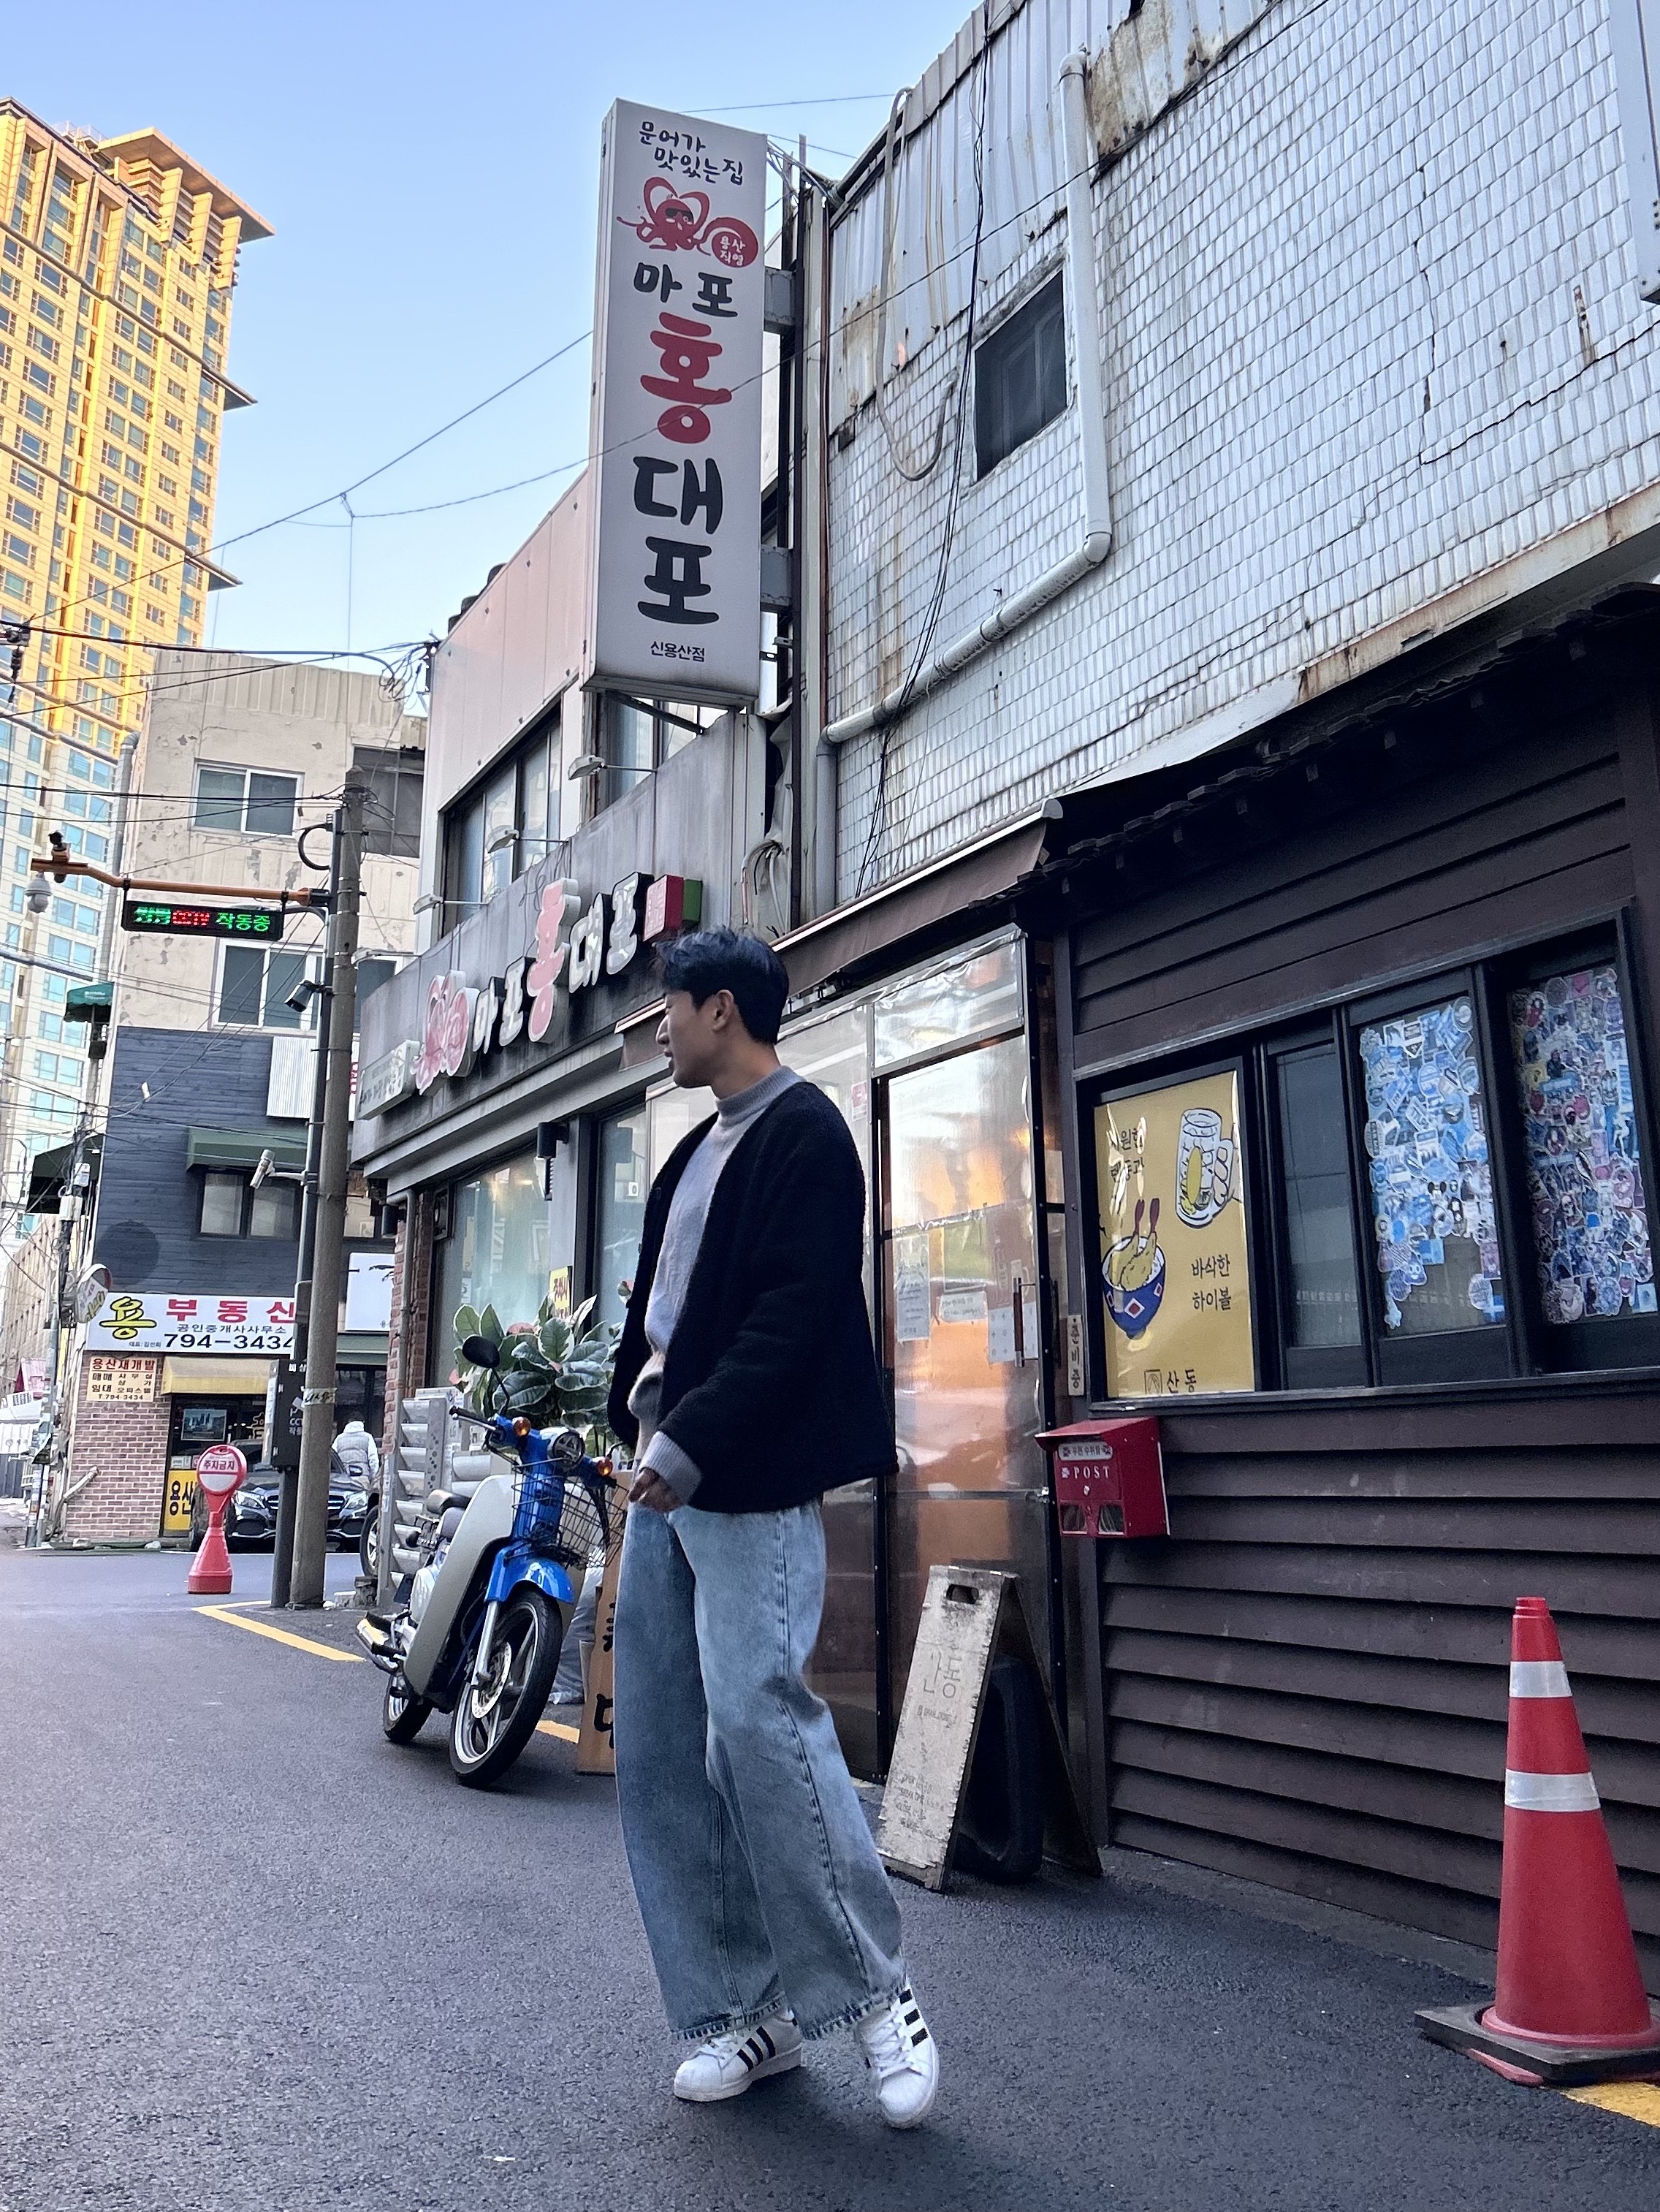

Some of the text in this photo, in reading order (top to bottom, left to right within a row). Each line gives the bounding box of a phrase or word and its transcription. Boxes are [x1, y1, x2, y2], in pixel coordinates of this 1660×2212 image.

[639, 121, 706, 152] 문어가
[654, 146, 743, 186] 맛있는집
[720, 235, 746, 254] 용산
[720, 250, 744, 266] 직영
[633, 262, 738, 318] 마포
[650, 641, 706, 662] 신용산점
[216, 912, 270, 933] 작동중
[1192, 1254, 1230, 1280] 바삭한
[1192, 1286, 1232, 1312] 하이볼
[178, 1324, 287, 1334] 공인중개사사무소
[164, 1334, 294, 1350] 794-3434
[92, 1358, 155, 1371] 용산재개발
[92, 1373, 113, 1381] 매매
[1073, 1465, 1110, 1480] POST
